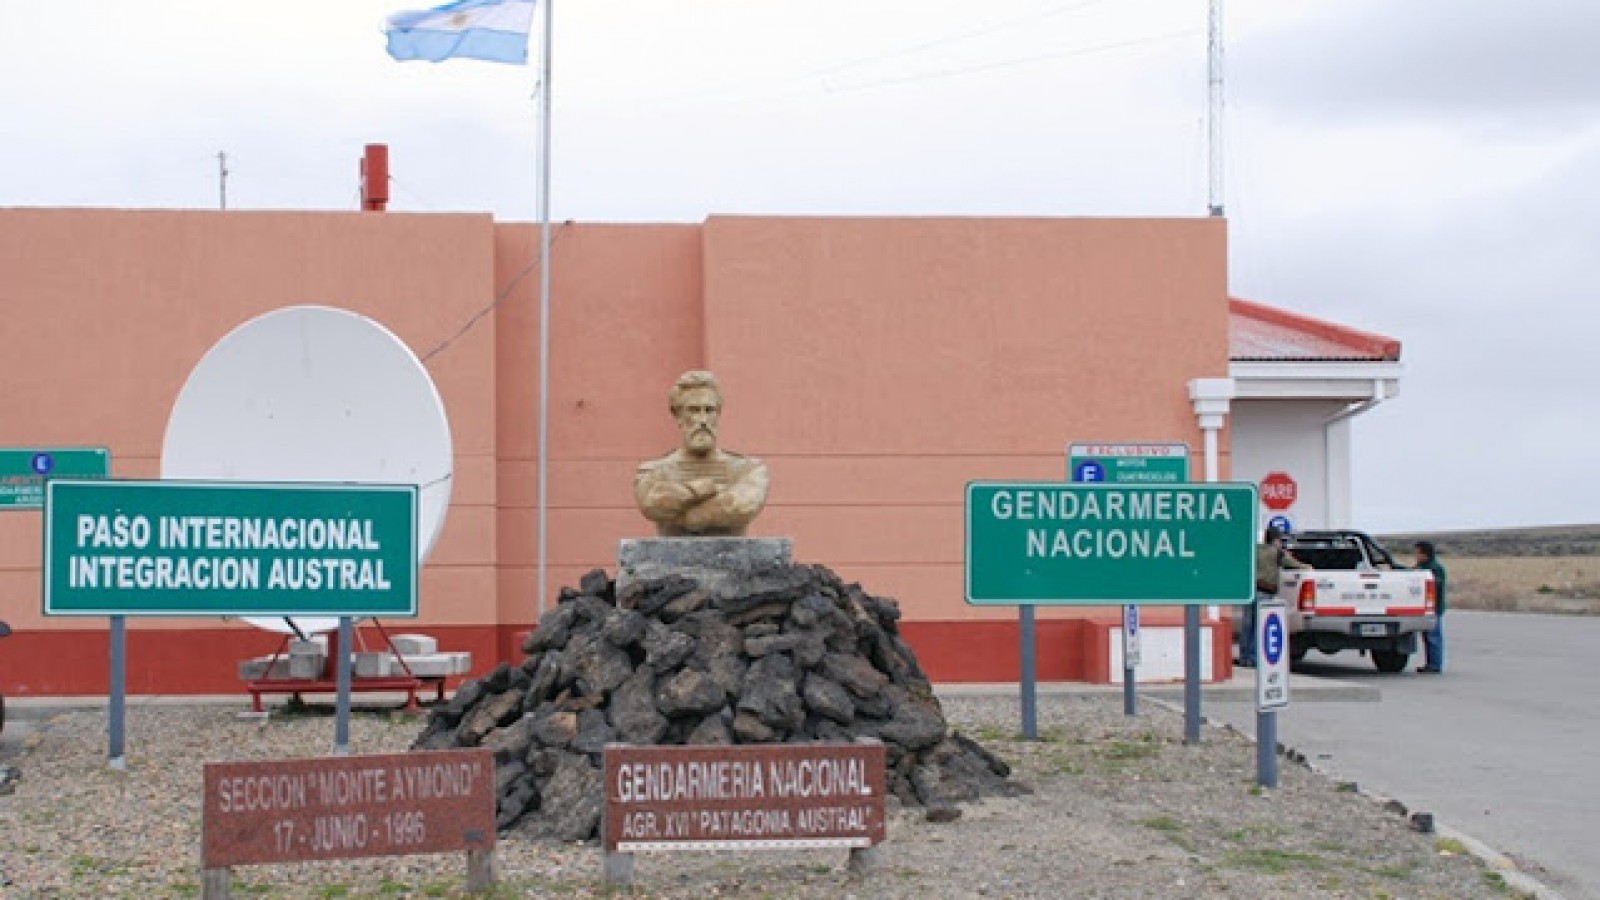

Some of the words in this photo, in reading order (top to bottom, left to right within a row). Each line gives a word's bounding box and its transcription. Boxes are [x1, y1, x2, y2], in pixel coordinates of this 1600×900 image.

[991, 490, 1231, 521] GENDARMERIA
[1261, 483, 1294, 499] PARE
[76, 514, 151, 548] PASO
[159, 516, 380, 550] INTERNACIONAL
[1026, 529, 1195, 559] NACIONAL
[69, 556, 259, 588] INTEGRACION
[268, 559, 391, 590] AUSTRAL
[1268, 623, 1278, 653] E
[617, 761, 765, 802] GENDARMERIA
[770, 757, 872, 798] NACIONAL
[273, 819, 294, 853] 17
[312, 814, 367, 850] JUNIO
